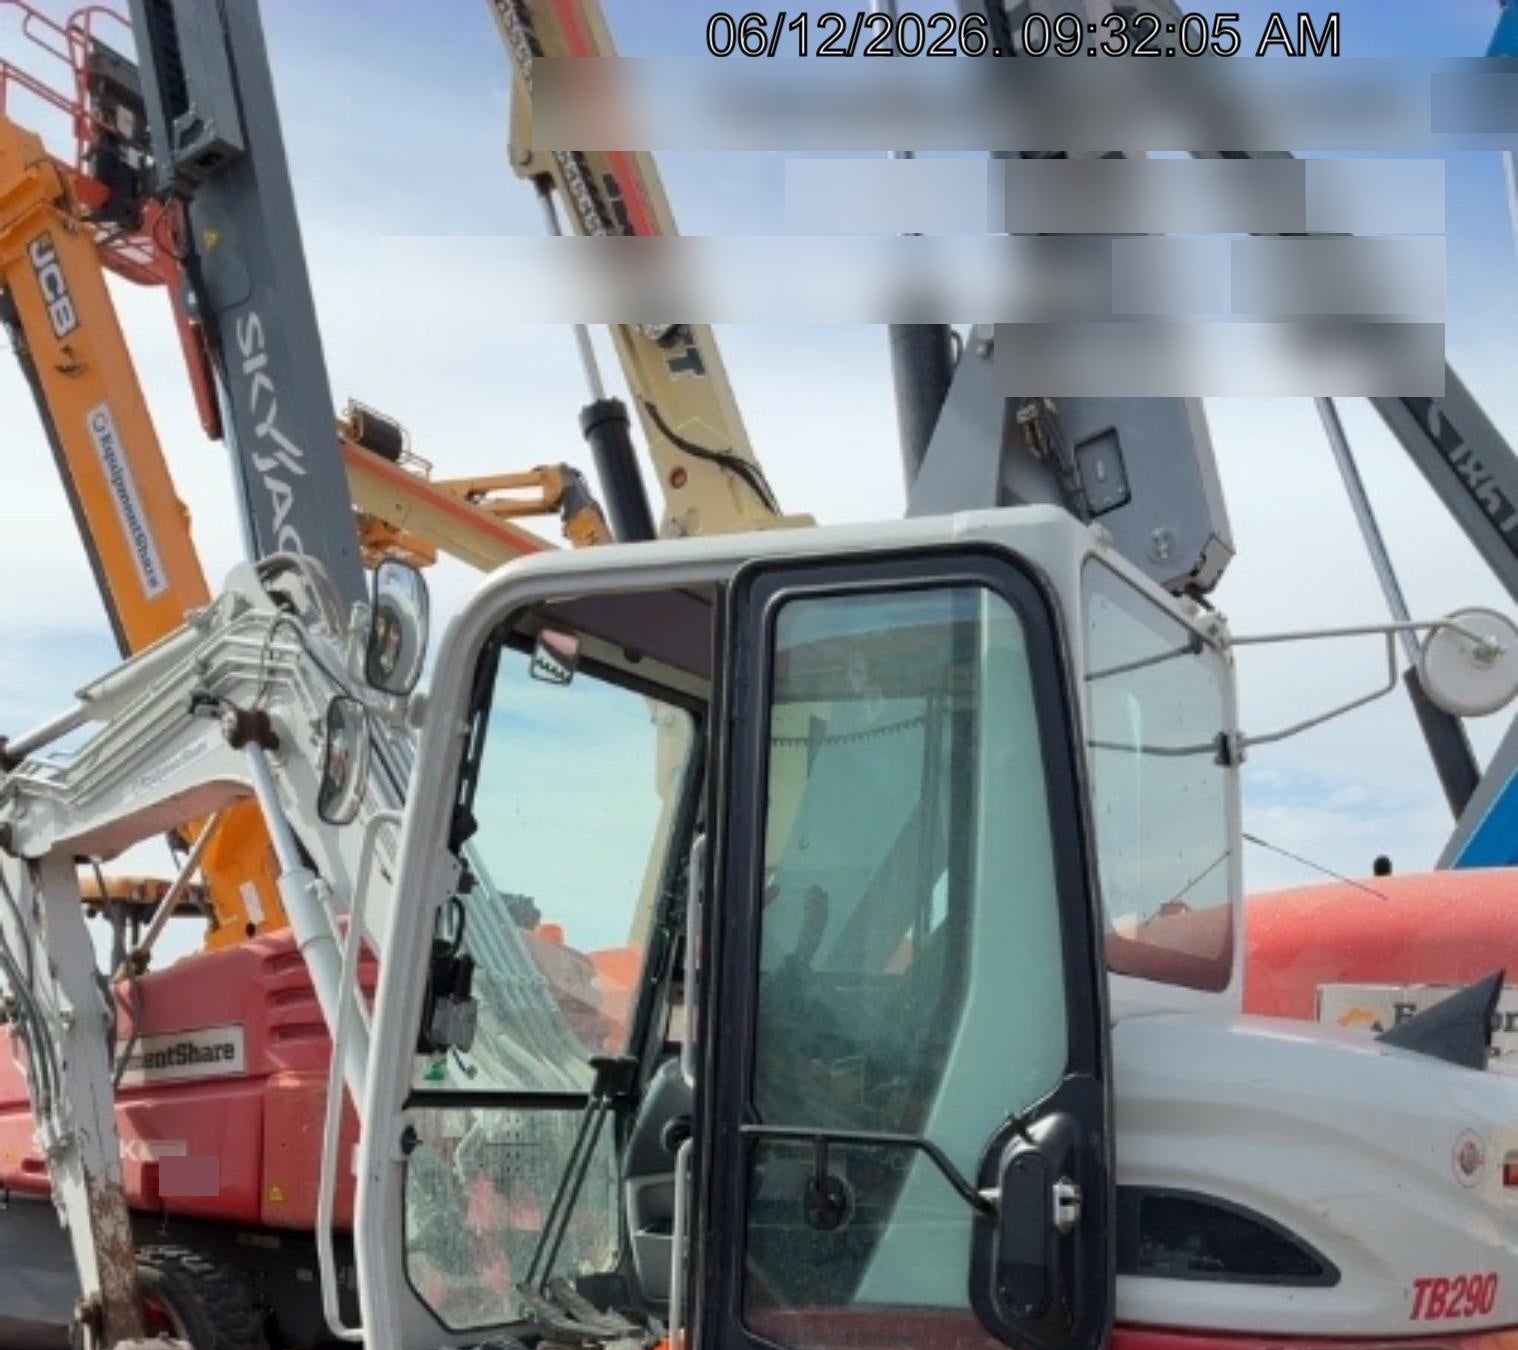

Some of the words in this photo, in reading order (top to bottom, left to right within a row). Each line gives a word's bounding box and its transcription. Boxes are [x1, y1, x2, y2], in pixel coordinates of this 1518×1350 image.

[28, 234, 77, 337] JCB
[236, 312, 307, 554] SKYJAC
[141, 1043, 235, 1069] entShare
[1409, 1272, 1498, 1321] TB290
